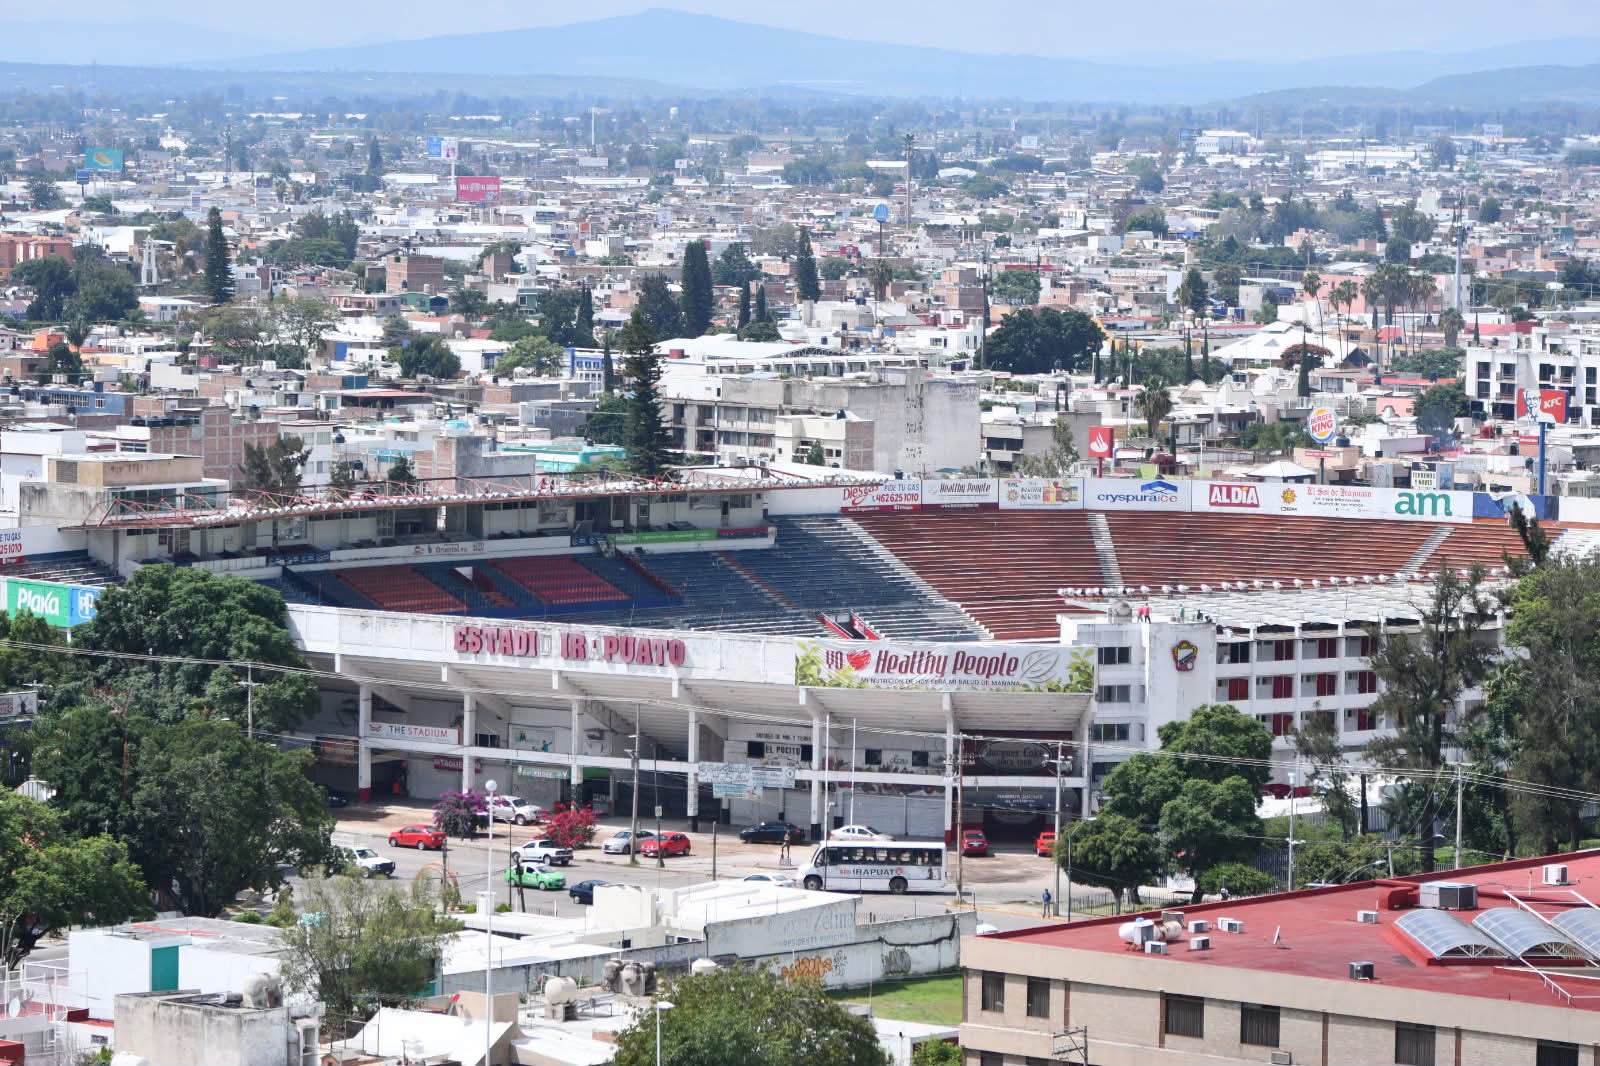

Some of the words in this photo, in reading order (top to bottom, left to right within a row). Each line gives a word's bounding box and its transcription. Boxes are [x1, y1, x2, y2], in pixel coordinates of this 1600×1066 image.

[1543, 397, 1562, 408] KFC
[1311, 414, 1332, 424] BURGER
[1312, 420, 1334, 434] KING
[1395, 492, 1452, 516] am
[454, 626, 551, 658] ESTADI
[875, 650, 947, 676] Healthy
[952, 651, 1020, 679] People
[389, 725, 406, 735] THE
[408, 727, 448, 738] STADIUM
[766, 744, 773, 754] EL
